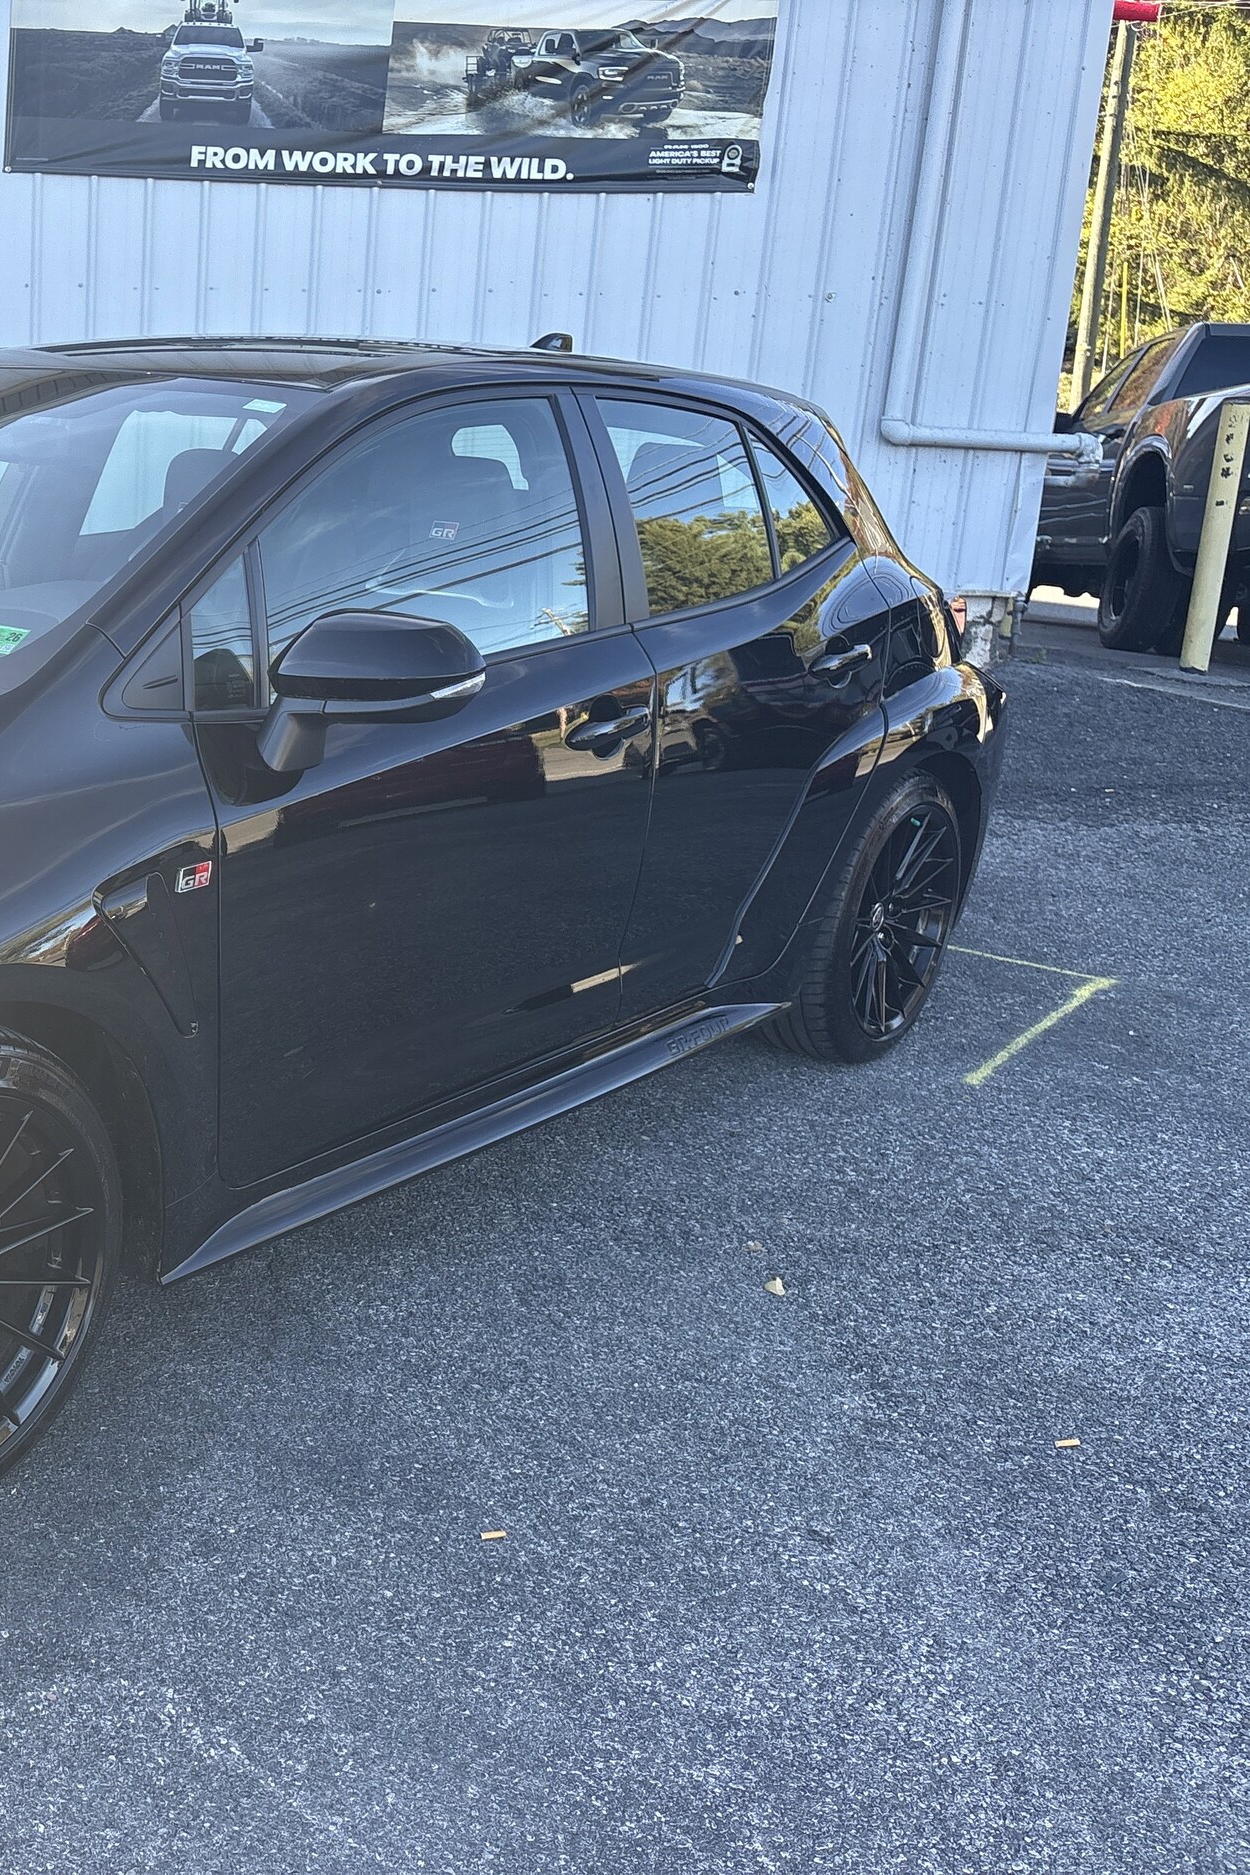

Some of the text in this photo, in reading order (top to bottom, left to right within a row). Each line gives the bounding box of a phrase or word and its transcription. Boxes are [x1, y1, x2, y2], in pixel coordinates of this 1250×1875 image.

[190, 145, 575, 180] FROM WORK TO THE WILD.
[432, 527, 455, 538] GR
[6, 632, 23, 643] 26
[181, 871, 208, 890] GR
